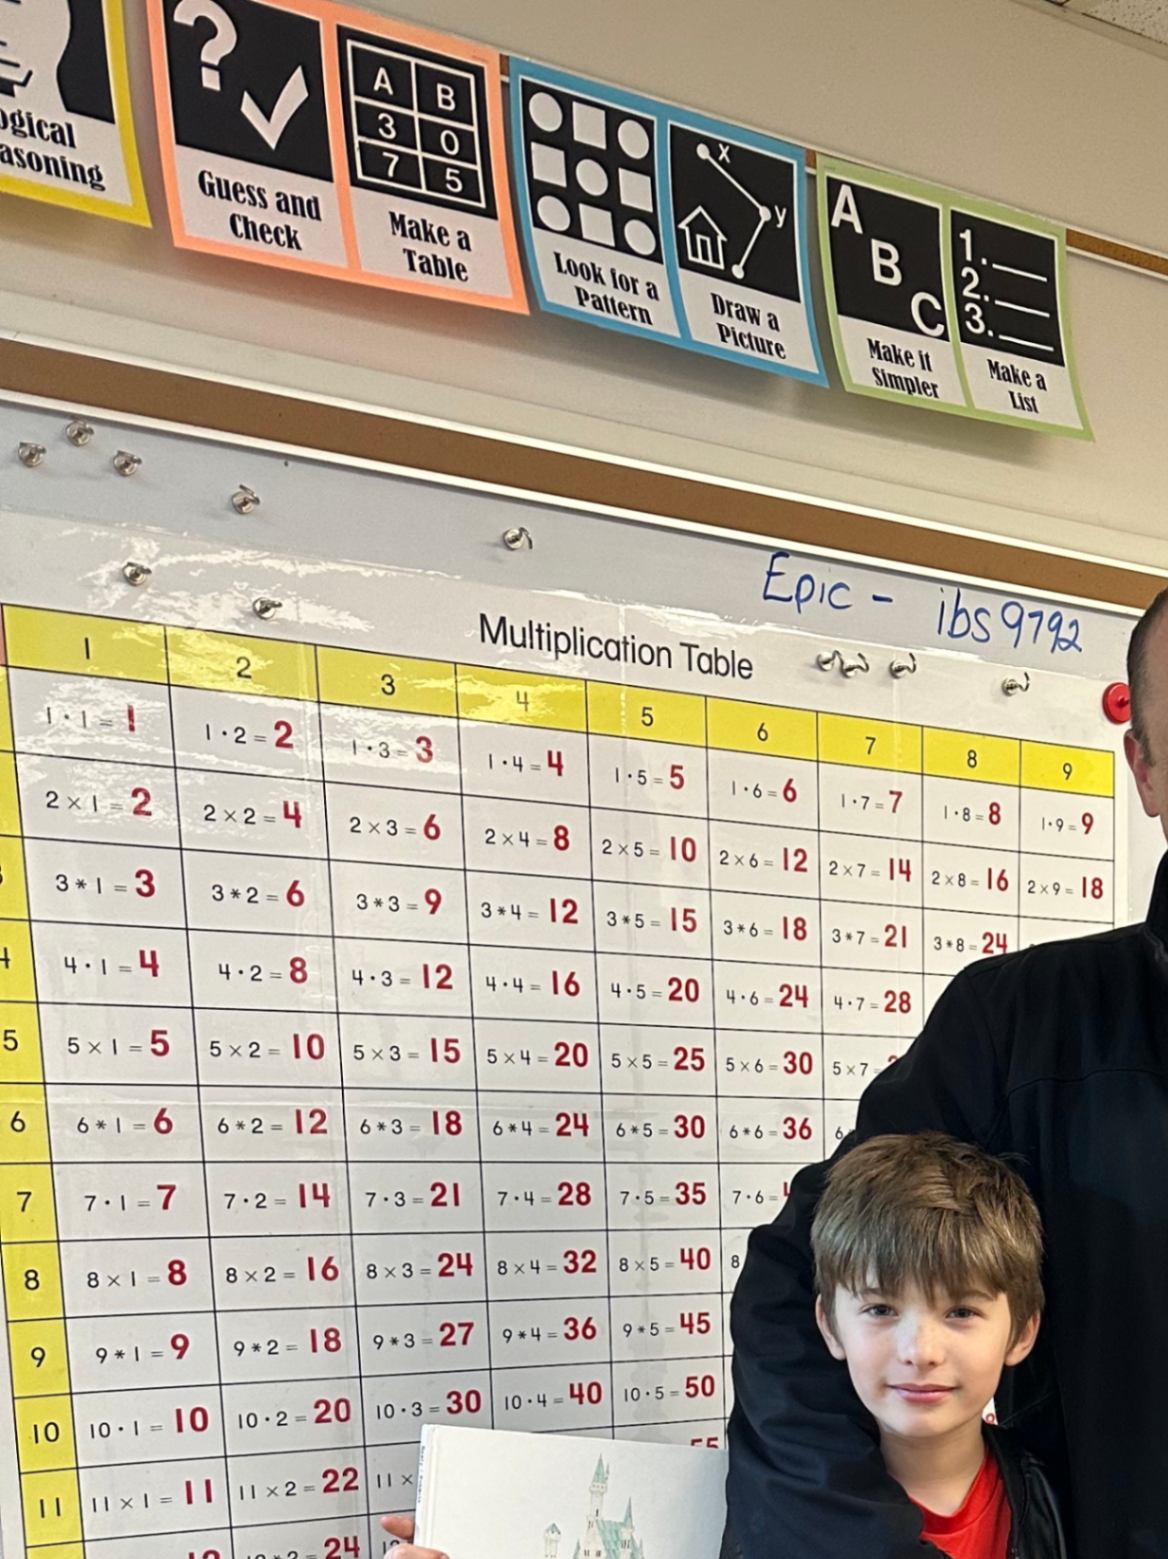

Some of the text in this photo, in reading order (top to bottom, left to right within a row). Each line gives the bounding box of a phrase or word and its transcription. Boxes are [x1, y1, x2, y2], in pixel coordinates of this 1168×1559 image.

[373, 67, 456, 112] A B
[377, 113, 397, 140] 3
[382, 153, 464, 193] 7 5
[198, 169, 323, 222] Guess and
[831, 185, 863, 234] A
[229, 213, 303, 252] Check
[389, 211, 472, 252] Make a
[959, 228, 988, 269] 1.
[402, 249, 470, 284] Table
[553, 250, 661, 302] Look for a
[871, 239, 902, 287] B
[962, 268, 991, 305] 2.
[575, 286, 654, 329] Pattern
[710, 292, 781, 333] Draw a
[910, 291, 945, 338] C
[965, 303, 995, 339] 3.
[717, 322, 787, 362] Picture
[867, 337, 933, 376] Make it
[873, 366, 940, 400] Simpler
[987, 358, 1047, 392] Make a
[1009, 389, 1039, 415] List
[762, 551, 853, 614] Epic
[479, 612, 754, 681] Multiplication Table
[84, 637, 1073, 781] 1 2 3 4 5 6 7 8 9
[671, 838, 696, 862] 10
[890, 859, 911, 882] 14
[551, 899, 577, 925] 12
[553, 972, 579, 998] 16
[3, 1030, 18, 1051] 5
[431, 1039, 460, 1063] 15
[10, 1111, 26, 1132] 6
[784, 1117, 812, 1139] 36
[16, 1191, 33, 1212] 7
[559, 1182, 591, 1205] 28
[24, 1269, 40, 1291] 8
[439, 1253, 473, 1277] 24
[680, 1312, 710, 1335] 45
[30, 1347, 45, 1367] 9
[315, 1399, 351, 1424] 20
[32, 1422, 60, 1444] 10
